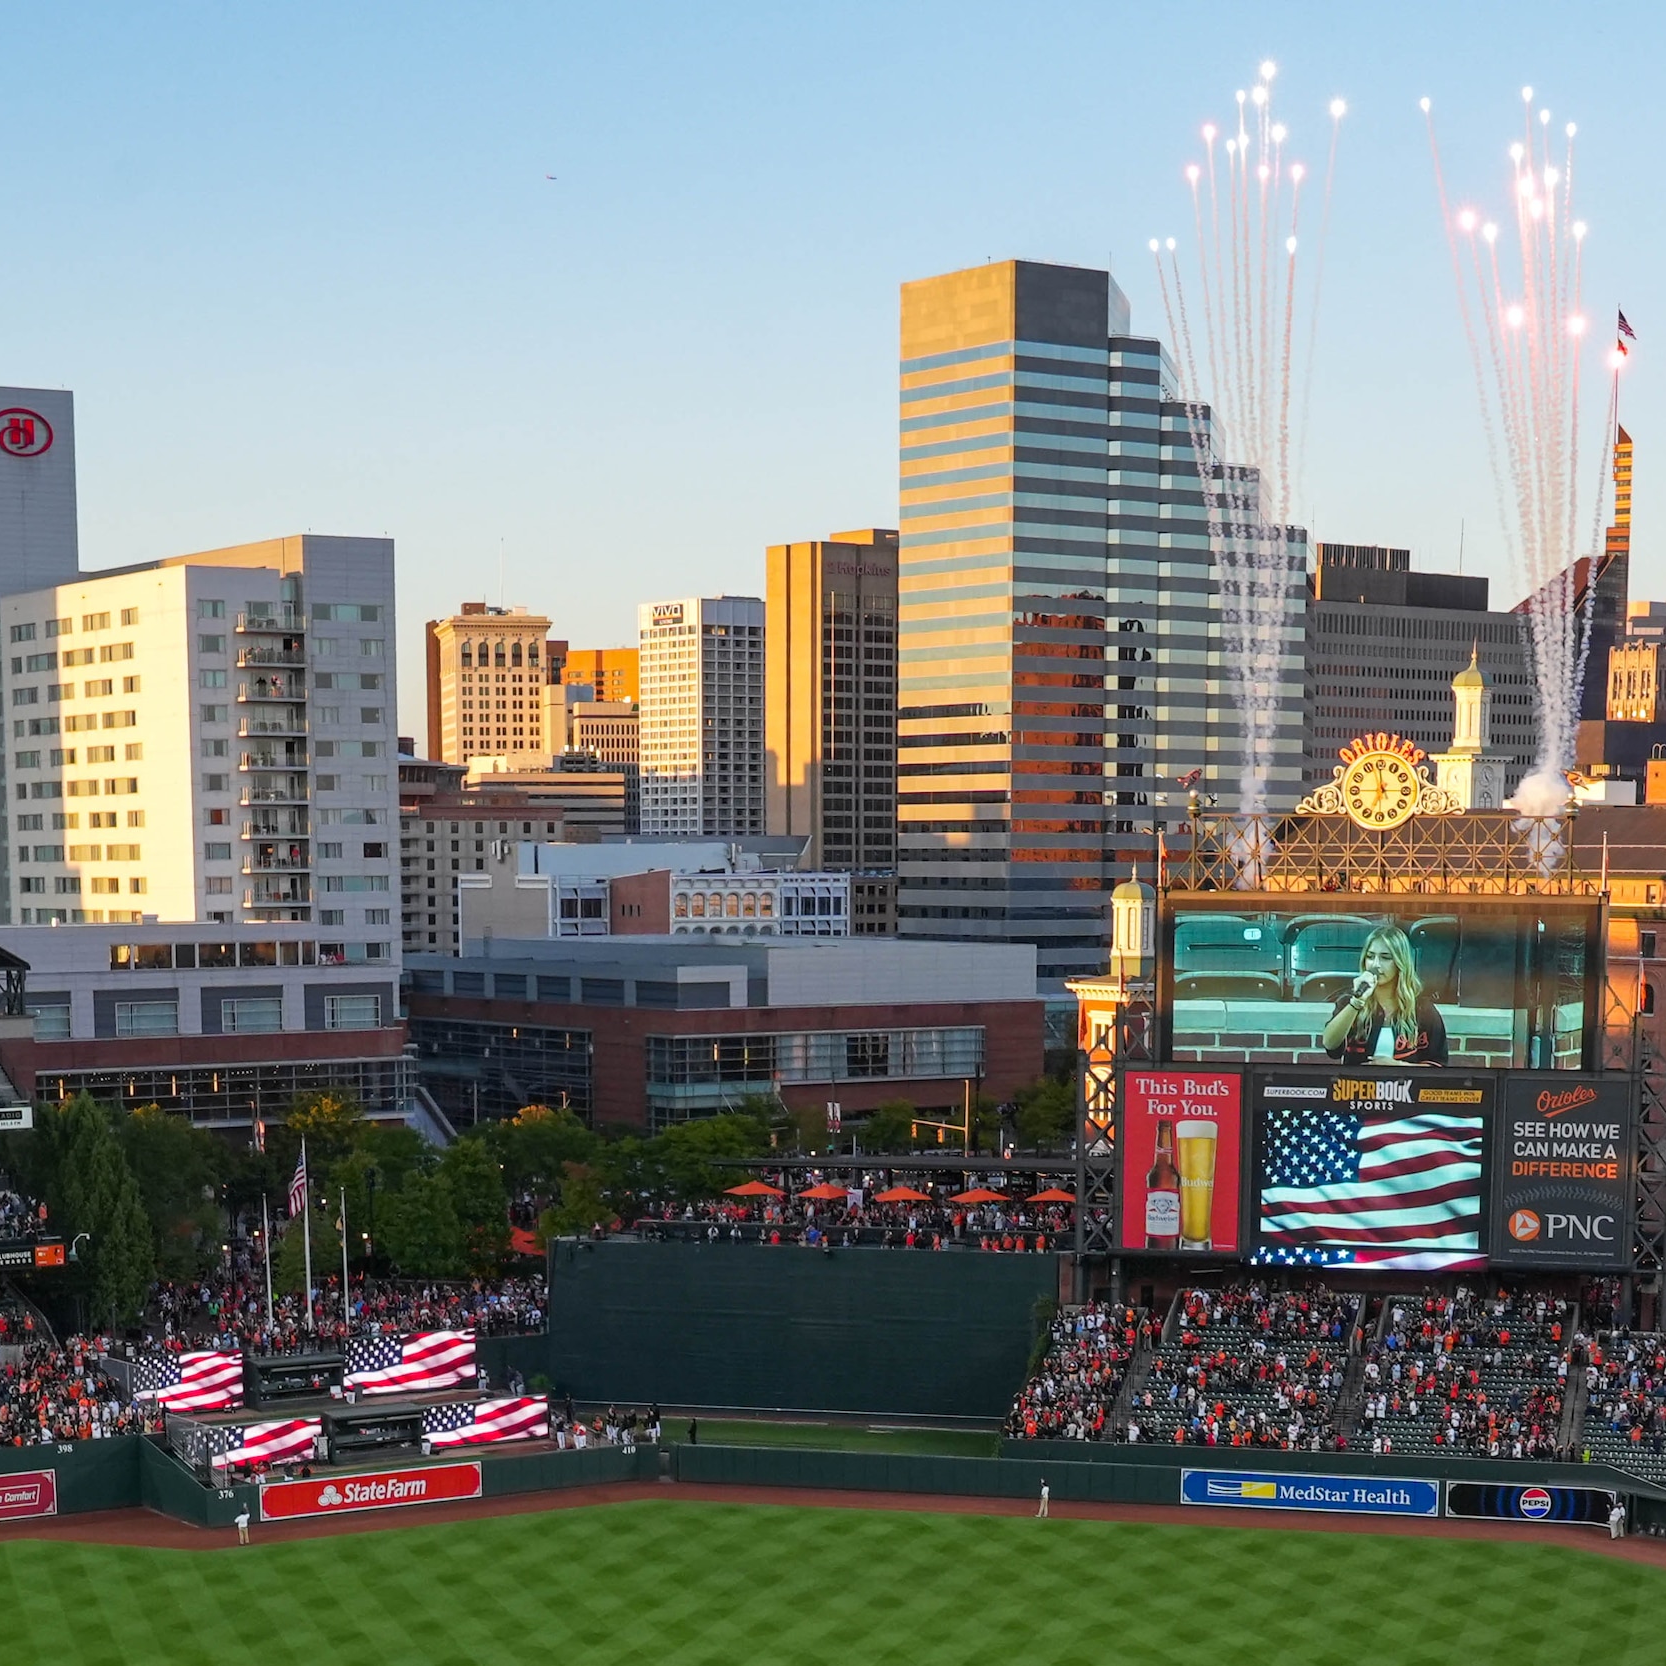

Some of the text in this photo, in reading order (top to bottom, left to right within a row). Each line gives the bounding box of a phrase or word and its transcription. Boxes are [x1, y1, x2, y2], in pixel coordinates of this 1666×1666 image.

[837, 561, 890, 577] Hopkins
[1339, 732, 1425, 766] ORIOLES
[1136, 1078, 1229, 1096] This Bud's
[1265, 1088, 1326, 1097] SUPERBOOK.COM
[1333, 1079, 1414, 1104] SUPERBOOK
[1147, 1099, 1218, 1116] For You.
[1349, 1101, 1394, 1111] SPORTS
[1536, 1085, 1597, 1114] Orioles
[1514, 1121, 1620, 1140] SEE HOW WE
[1514, 1141, 1617, 1159] CAN MAKE A
[1512, 1161, 1617, 1179] DIFFERENCE
[1545, 1213, 1614, 1240] PNC
[56, 1443, 73, 1454] 398
[621, 1445, 636, 1454] 410
[4, 1490, 36, 1503] Comfort
[218, 1489, 234, 1499] 376
[1280, 1484, 1411, 1505] MedStar Health
[1521, 1498, 1550, 1508] PEPSI
